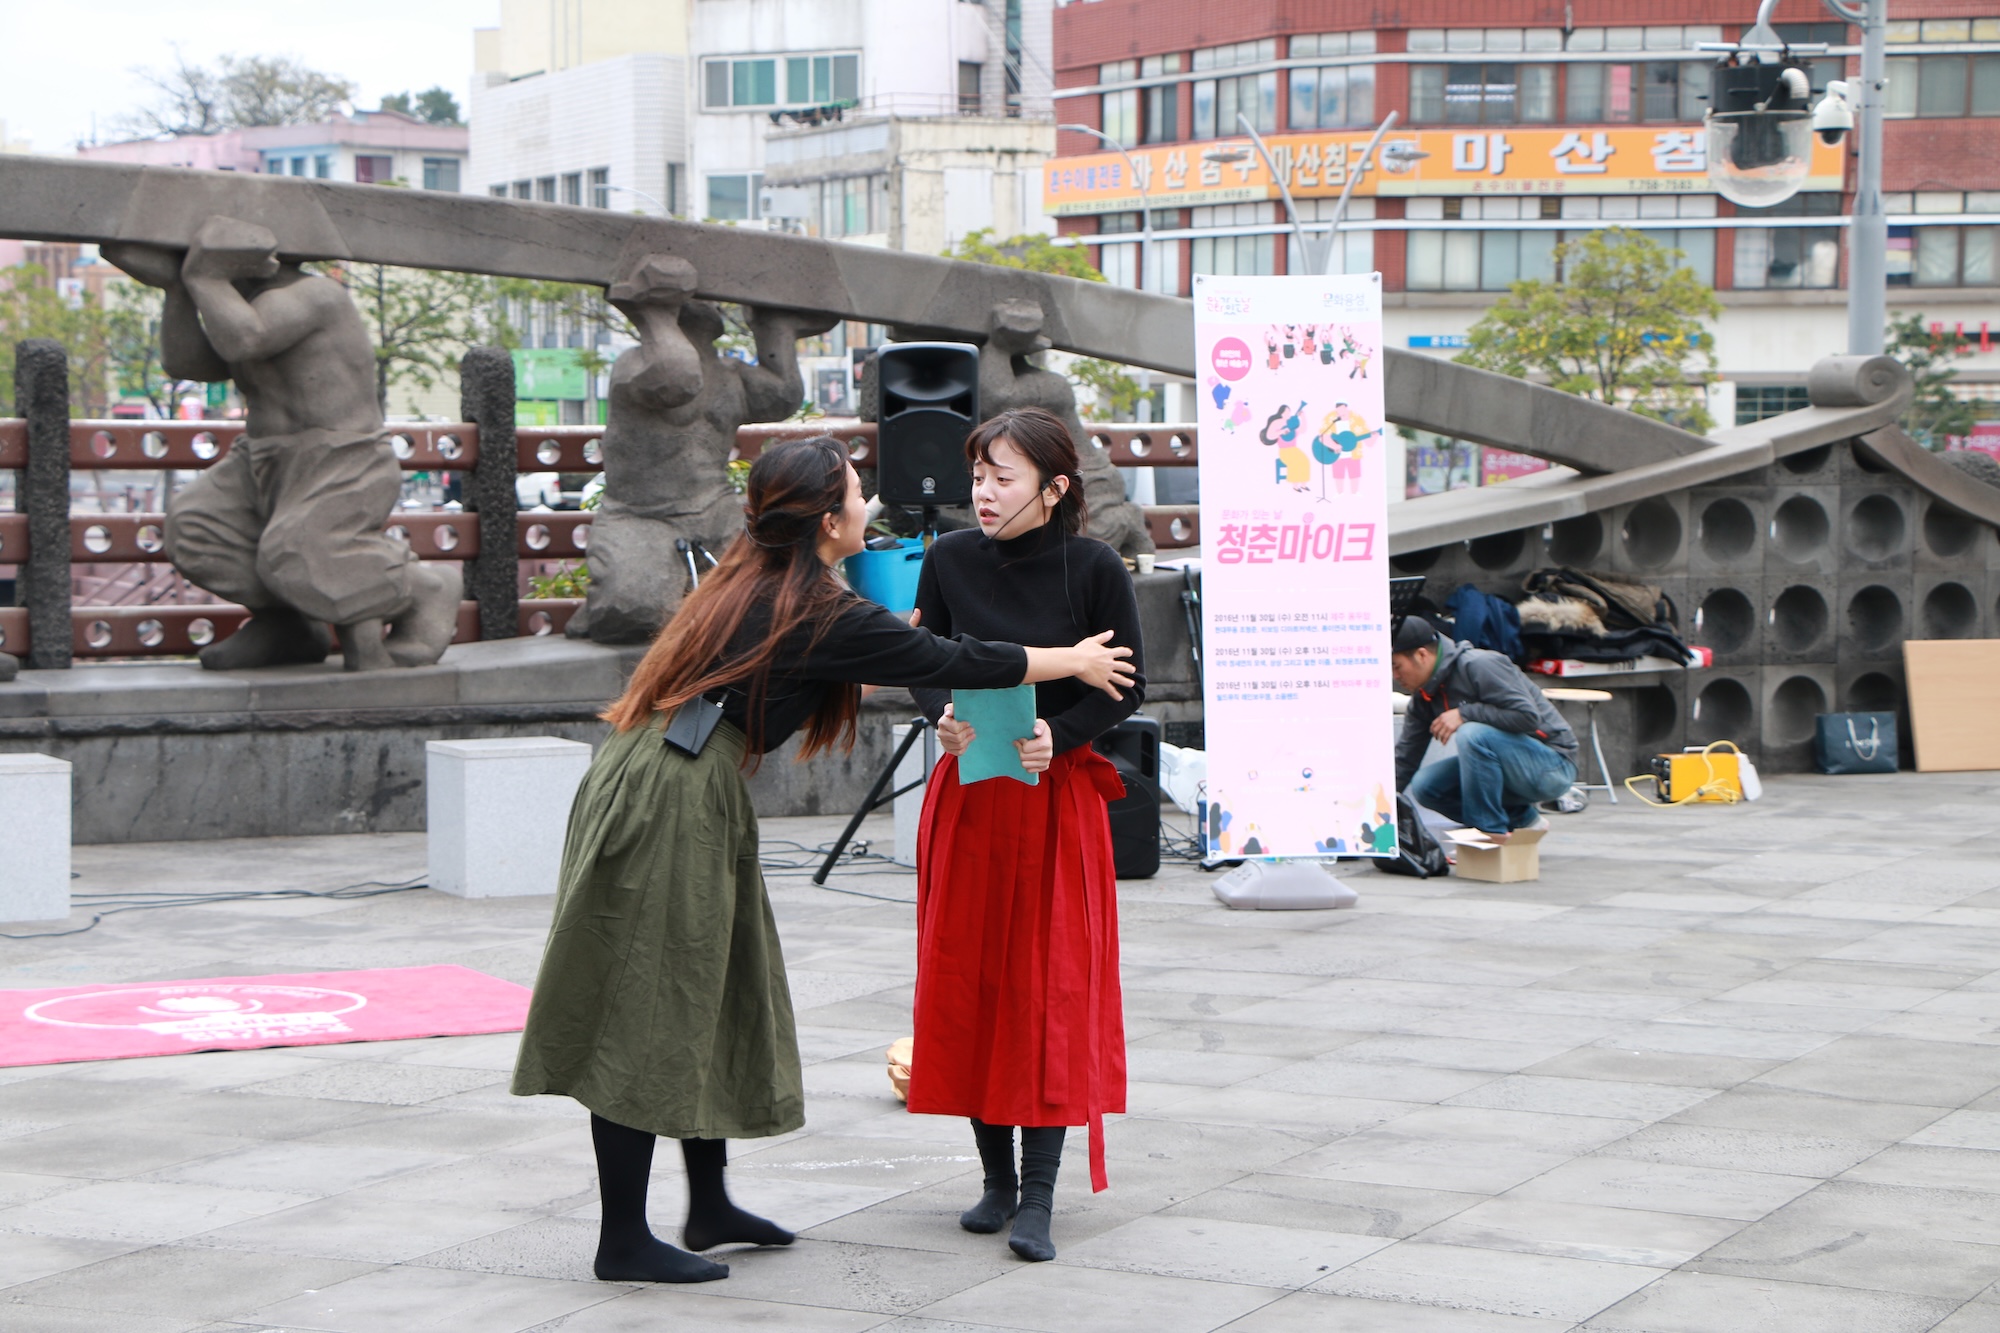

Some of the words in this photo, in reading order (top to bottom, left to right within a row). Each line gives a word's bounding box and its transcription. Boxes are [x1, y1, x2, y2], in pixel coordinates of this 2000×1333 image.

[1453, 131, 1708, 175] 마산침
[1270, 142, 1374, 187] 마산침구
[1323, 293, 1365, 308] 문화융성
[1222, 509, 1248, 520] 문화가
[1217, 523, 1376, 564] 청춘마이크
[1241, 613, 1257, 622] 11월
[1259, 613, 1275, 622] 30일
[1278, 613, 1291, 621] (수)
[1294, 613, 1309, 621] 오전
[1311, 612, 1328, 621] 11시
[1242, 647, 1257, 656] 11월
[1260, 647, 1276, 656] 30일
[1279, 647, 1292, 655] (수)
[1295, 647, 1309, 655] 오후
[1243, 681, 1258, 690] 11월
[1261, 681, 1277, 690] 30일
[1279, 681, 1293, 689] (수)
[1296, 680, 1310, 688] 오후
